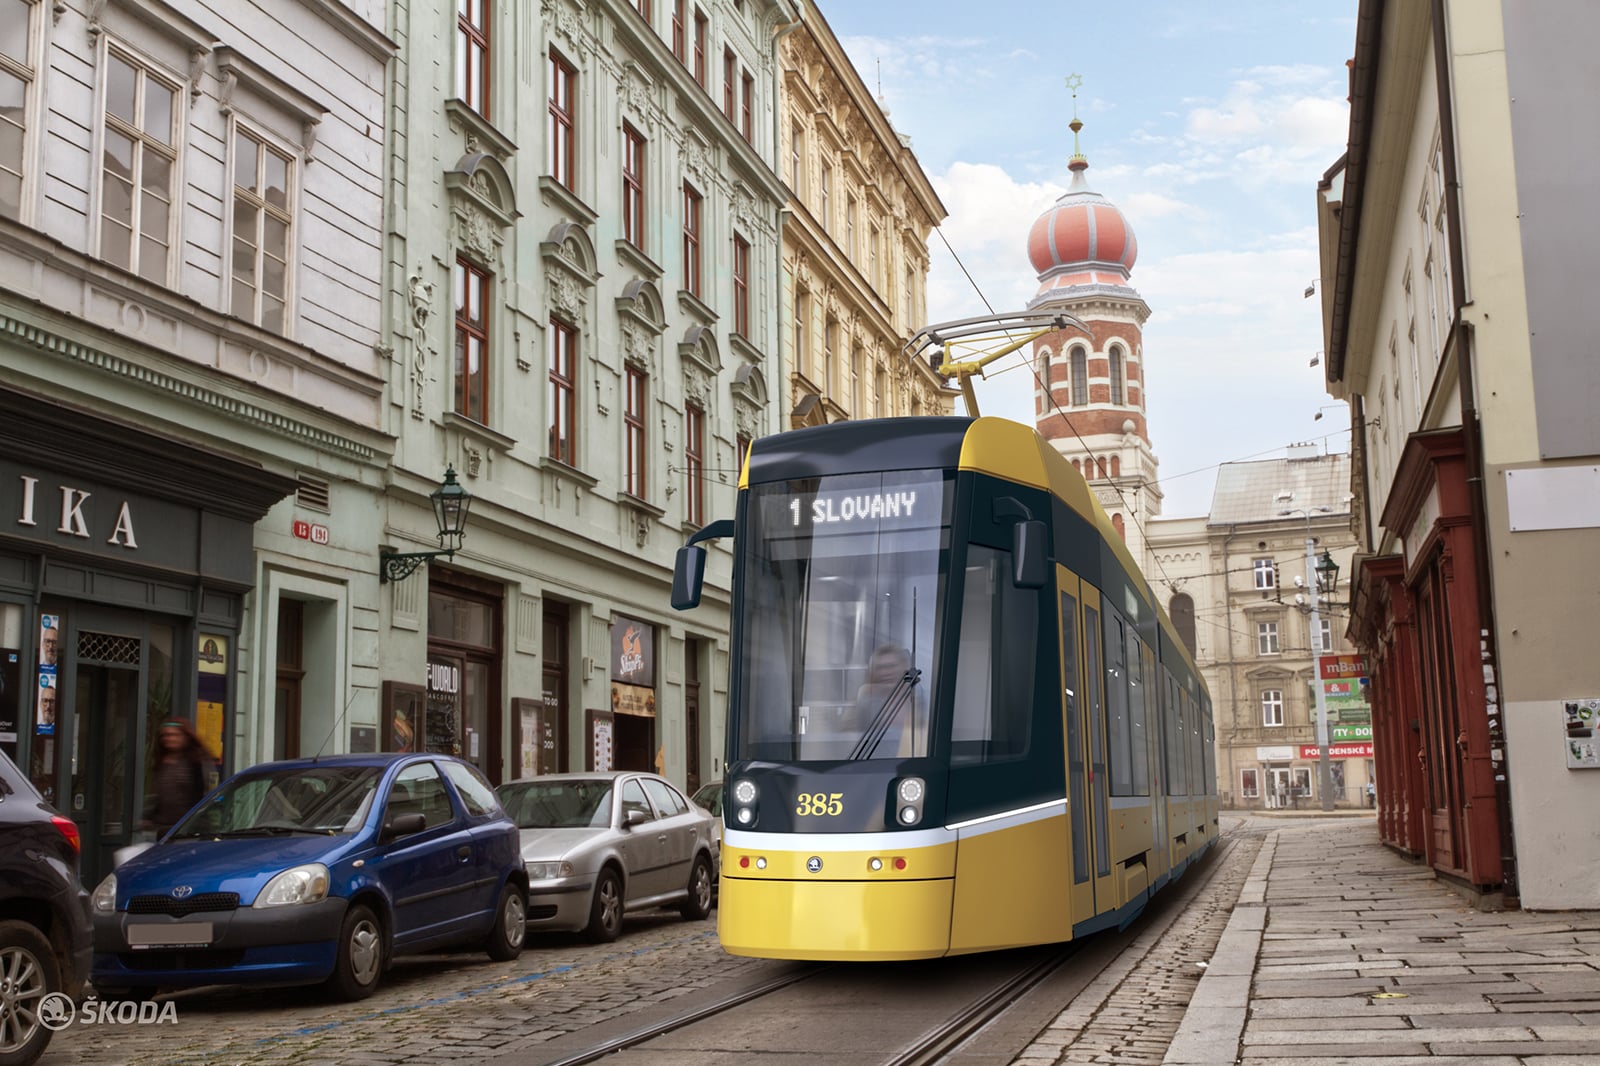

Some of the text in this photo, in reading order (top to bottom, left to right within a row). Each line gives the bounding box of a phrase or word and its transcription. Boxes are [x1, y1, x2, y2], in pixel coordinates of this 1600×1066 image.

[18, 475, 138, 549] IKA
[790, 491, 916, 526] 1 SLOVANY
[299, 523, 307, 537] 15
[796, 793, 844, 816] 385
